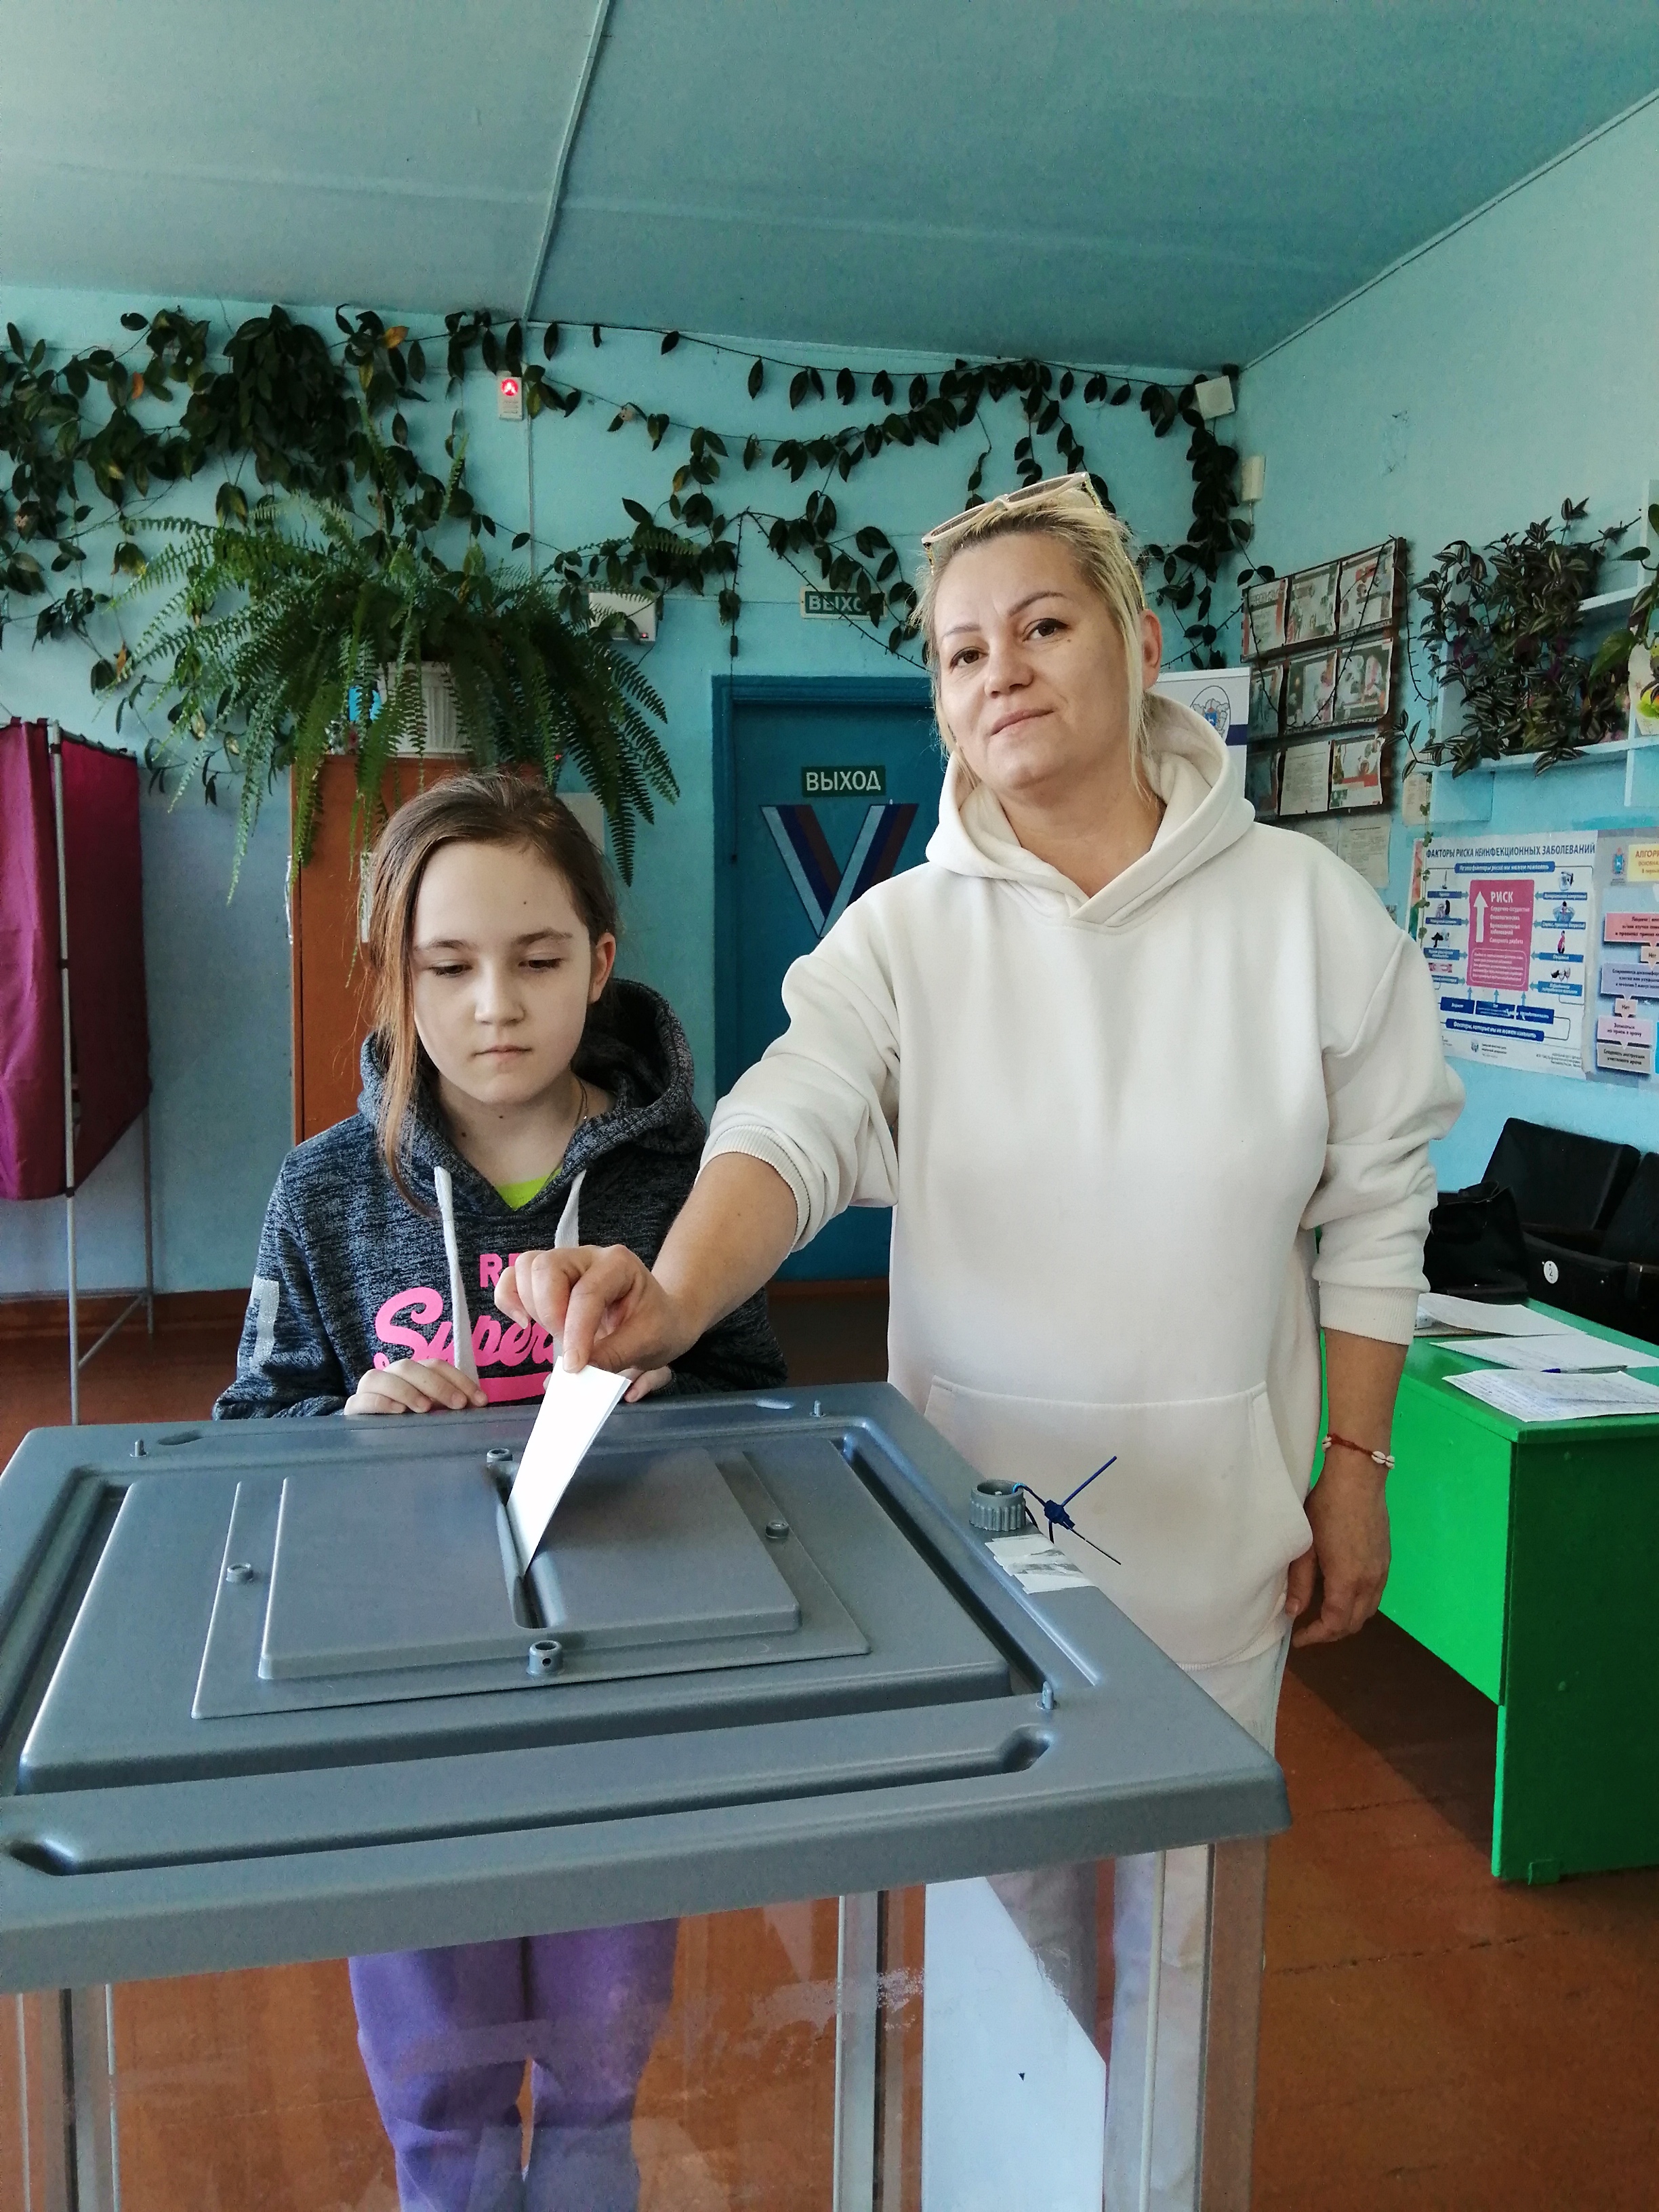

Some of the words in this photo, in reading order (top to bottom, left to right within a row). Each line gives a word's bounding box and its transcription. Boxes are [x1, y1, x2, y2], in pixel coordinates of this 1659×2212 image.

[808, 595, 864, 612] ВЫХО
[806, 771, 881, 791] ВЫХОД
[1426, 848, 1455, 859] ФАКТОРЫ
[1456, 848, 1474, 857] РИСКА
[1475, 846, 1541, 857] НЕИНФЕКЦИОННЫХ
[1542, 842, 1595, 855] ЗАБОЛЕВАНИЙ
[1490, 891, 1513, 903] РИСК
